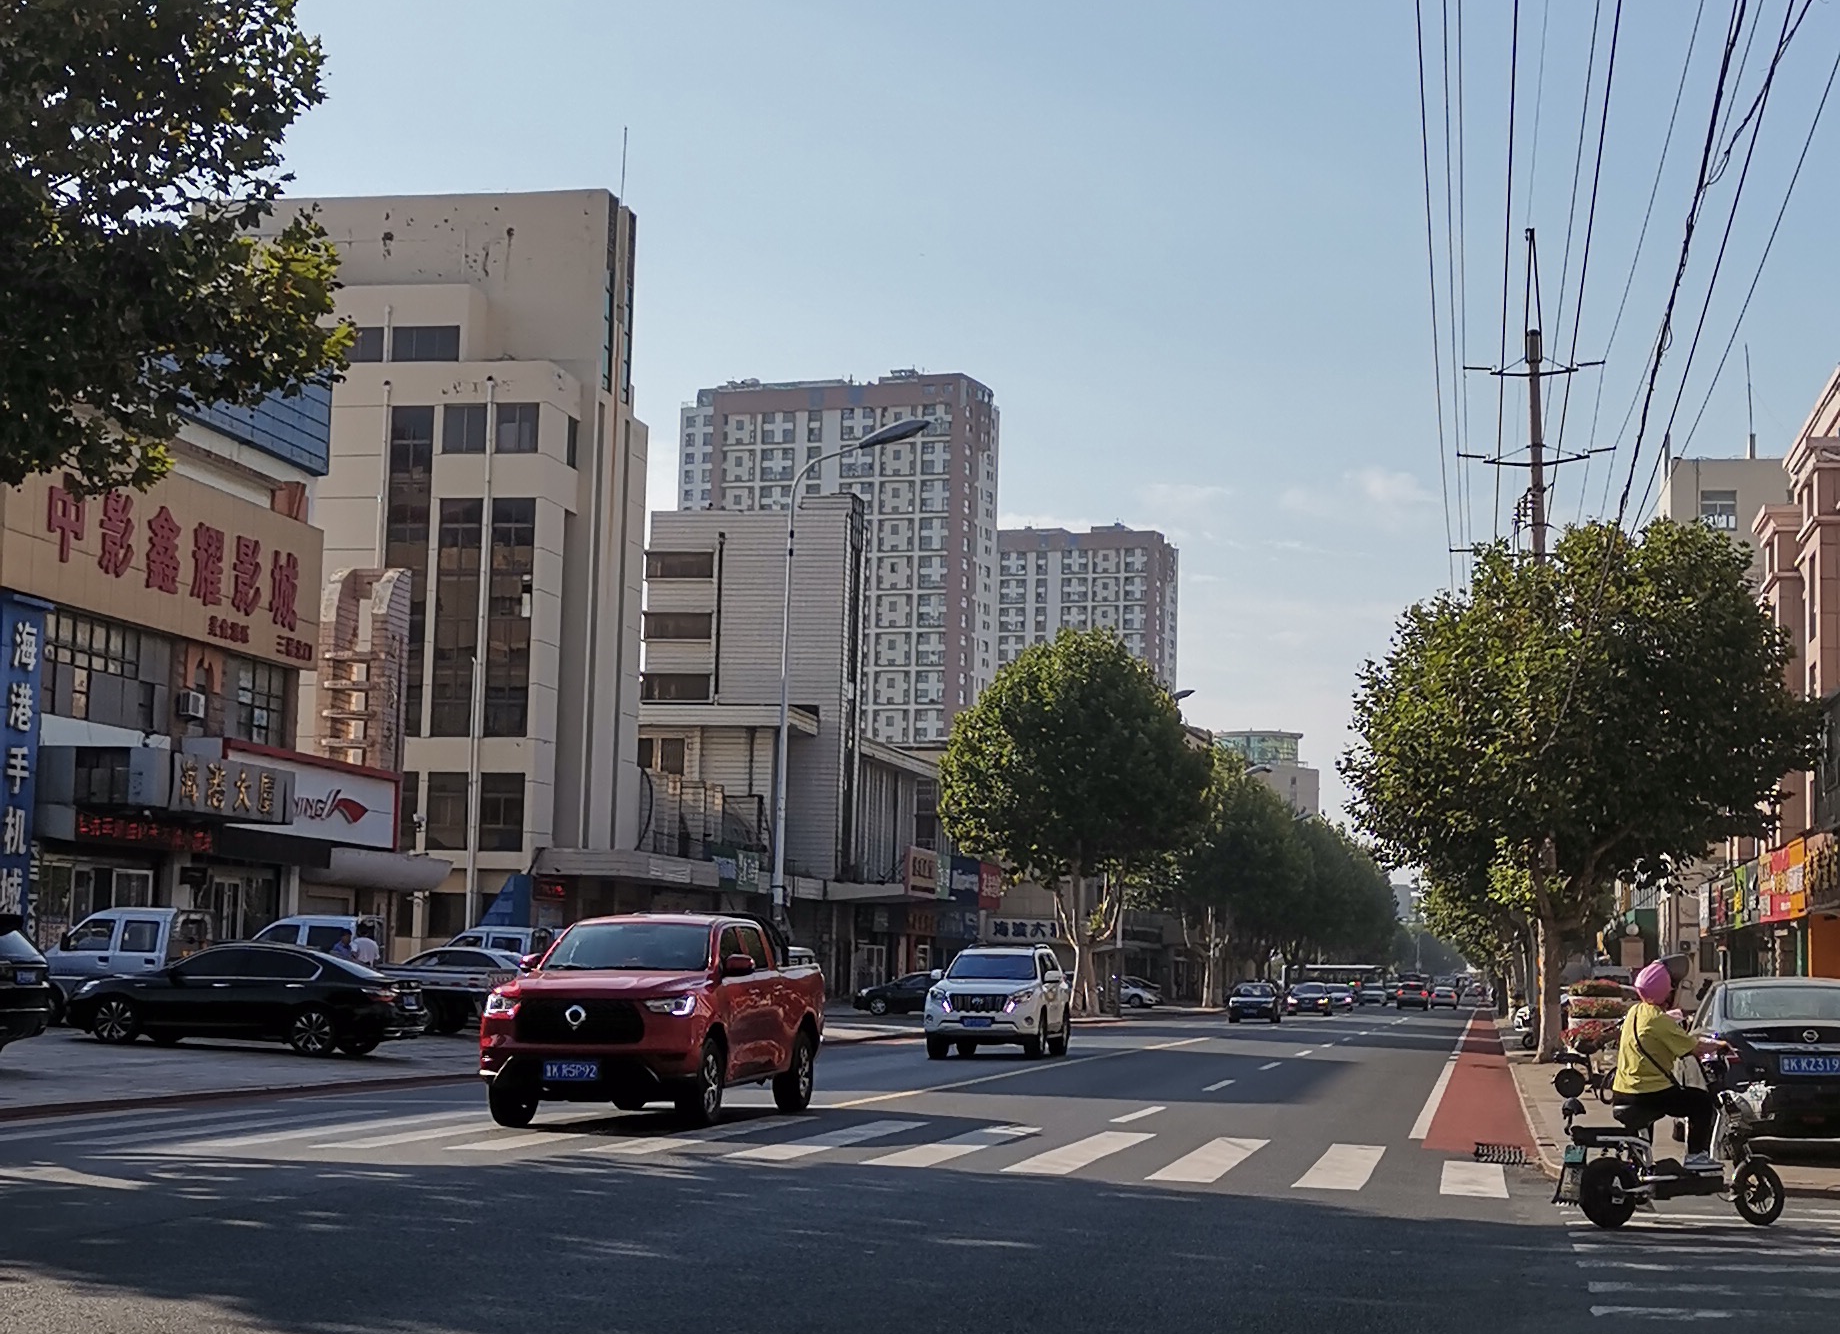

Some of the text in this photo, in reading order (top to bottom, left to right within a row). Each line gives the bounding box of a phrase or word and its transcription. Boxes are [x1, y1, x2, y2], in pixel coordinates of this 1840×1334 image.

[47, 473, 299, 632] 中影鑫耀影城
[0, 621, 37, 915] 海港手机城
